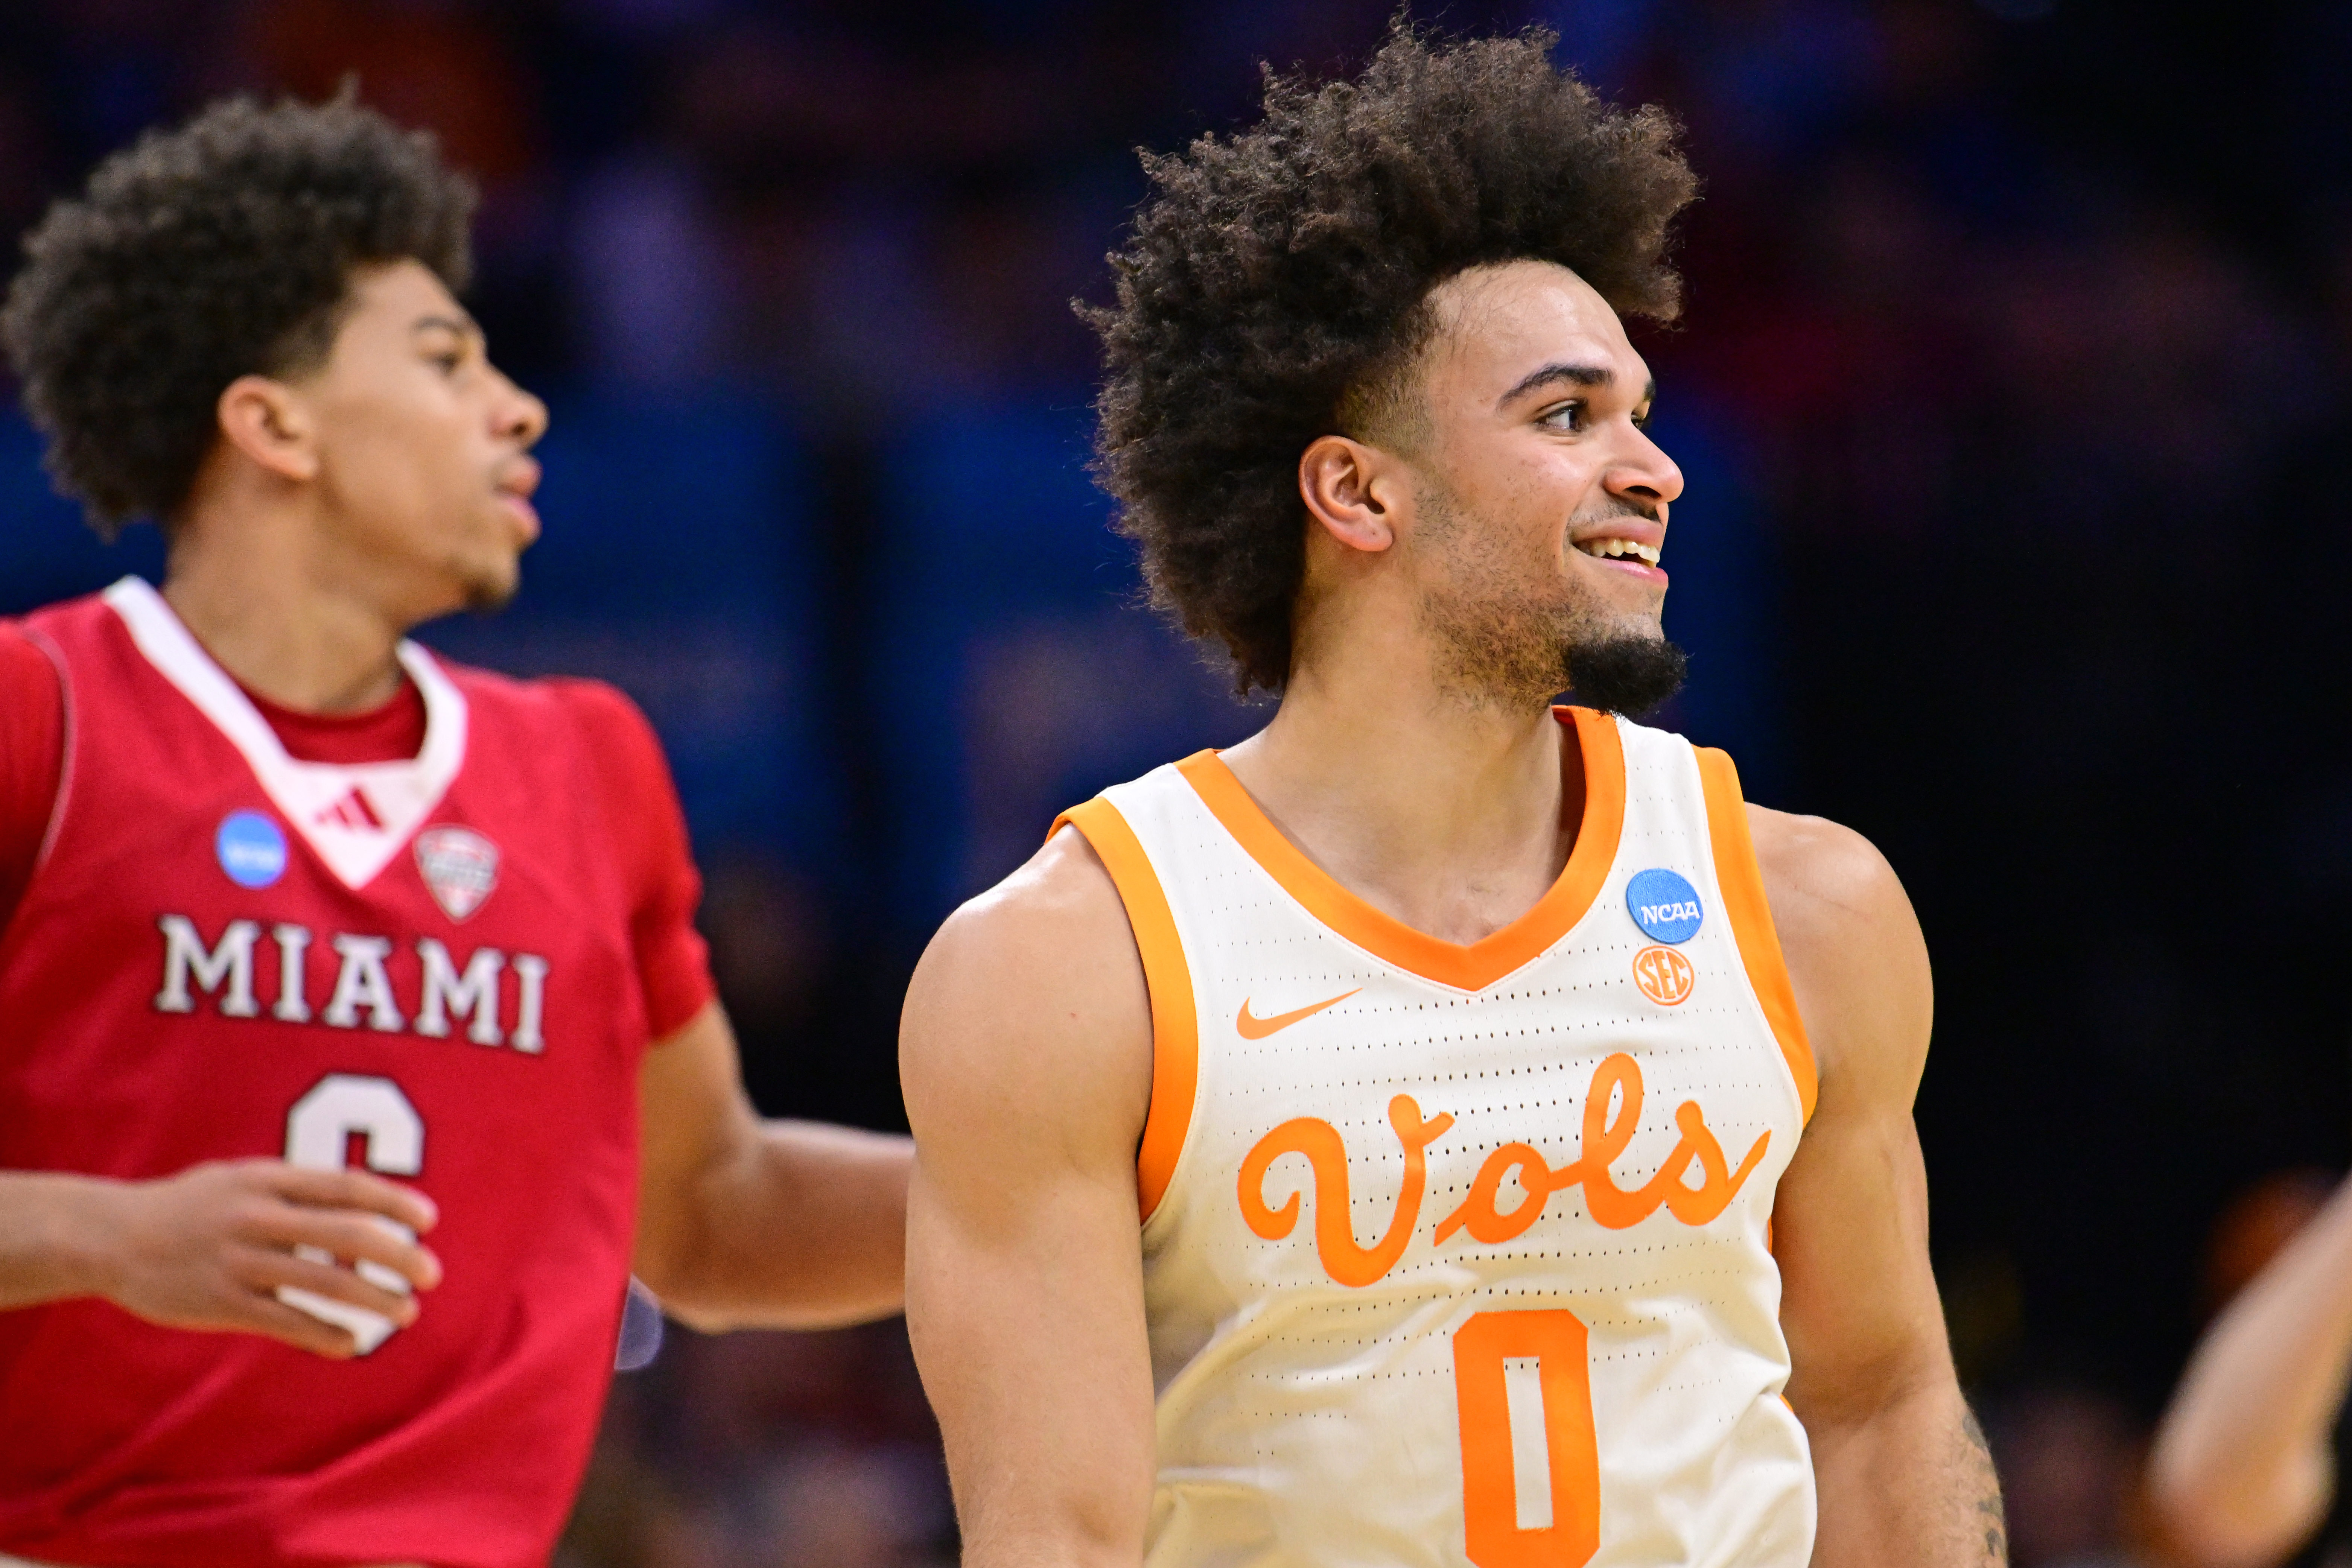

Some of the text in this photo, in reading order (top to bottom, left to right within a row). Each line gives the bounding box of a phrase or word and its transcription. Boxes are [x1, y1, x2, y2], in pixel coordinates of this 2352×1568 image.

[1638, 951, 1689, 999] SEC
[1640, 901, 1700, 925] NCAA
[153, 914, 551, 1054] MIAMI
[1237, 1052, 1772, 1288] Vols
[1453, 1309, 1601, 1568] 0
